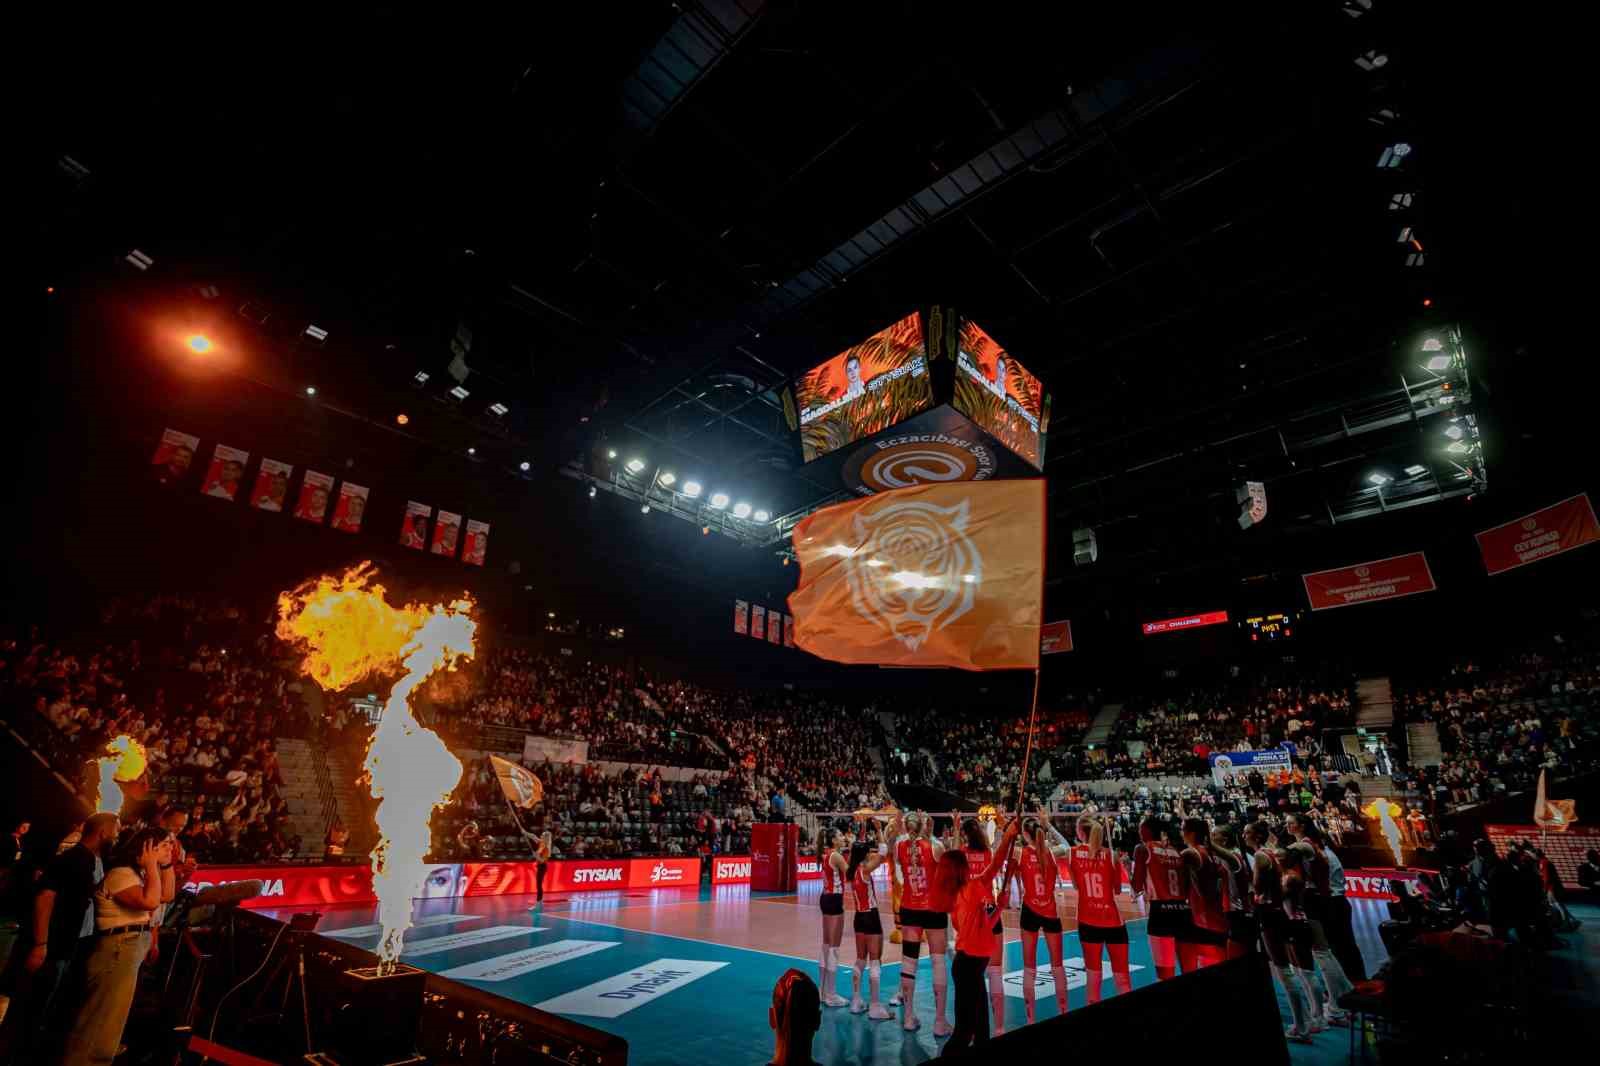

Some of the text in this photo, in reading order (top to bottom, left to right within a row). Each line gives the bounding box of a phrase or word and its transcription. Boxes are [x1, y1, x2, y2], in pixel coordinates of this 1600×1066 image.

[573, 867, 624, 884] STYSIAK
[717, 861, 752, 878] İSTAN
[1034, 873, 1046, 897] 6
[1083, 872, 1104, 899] 16
